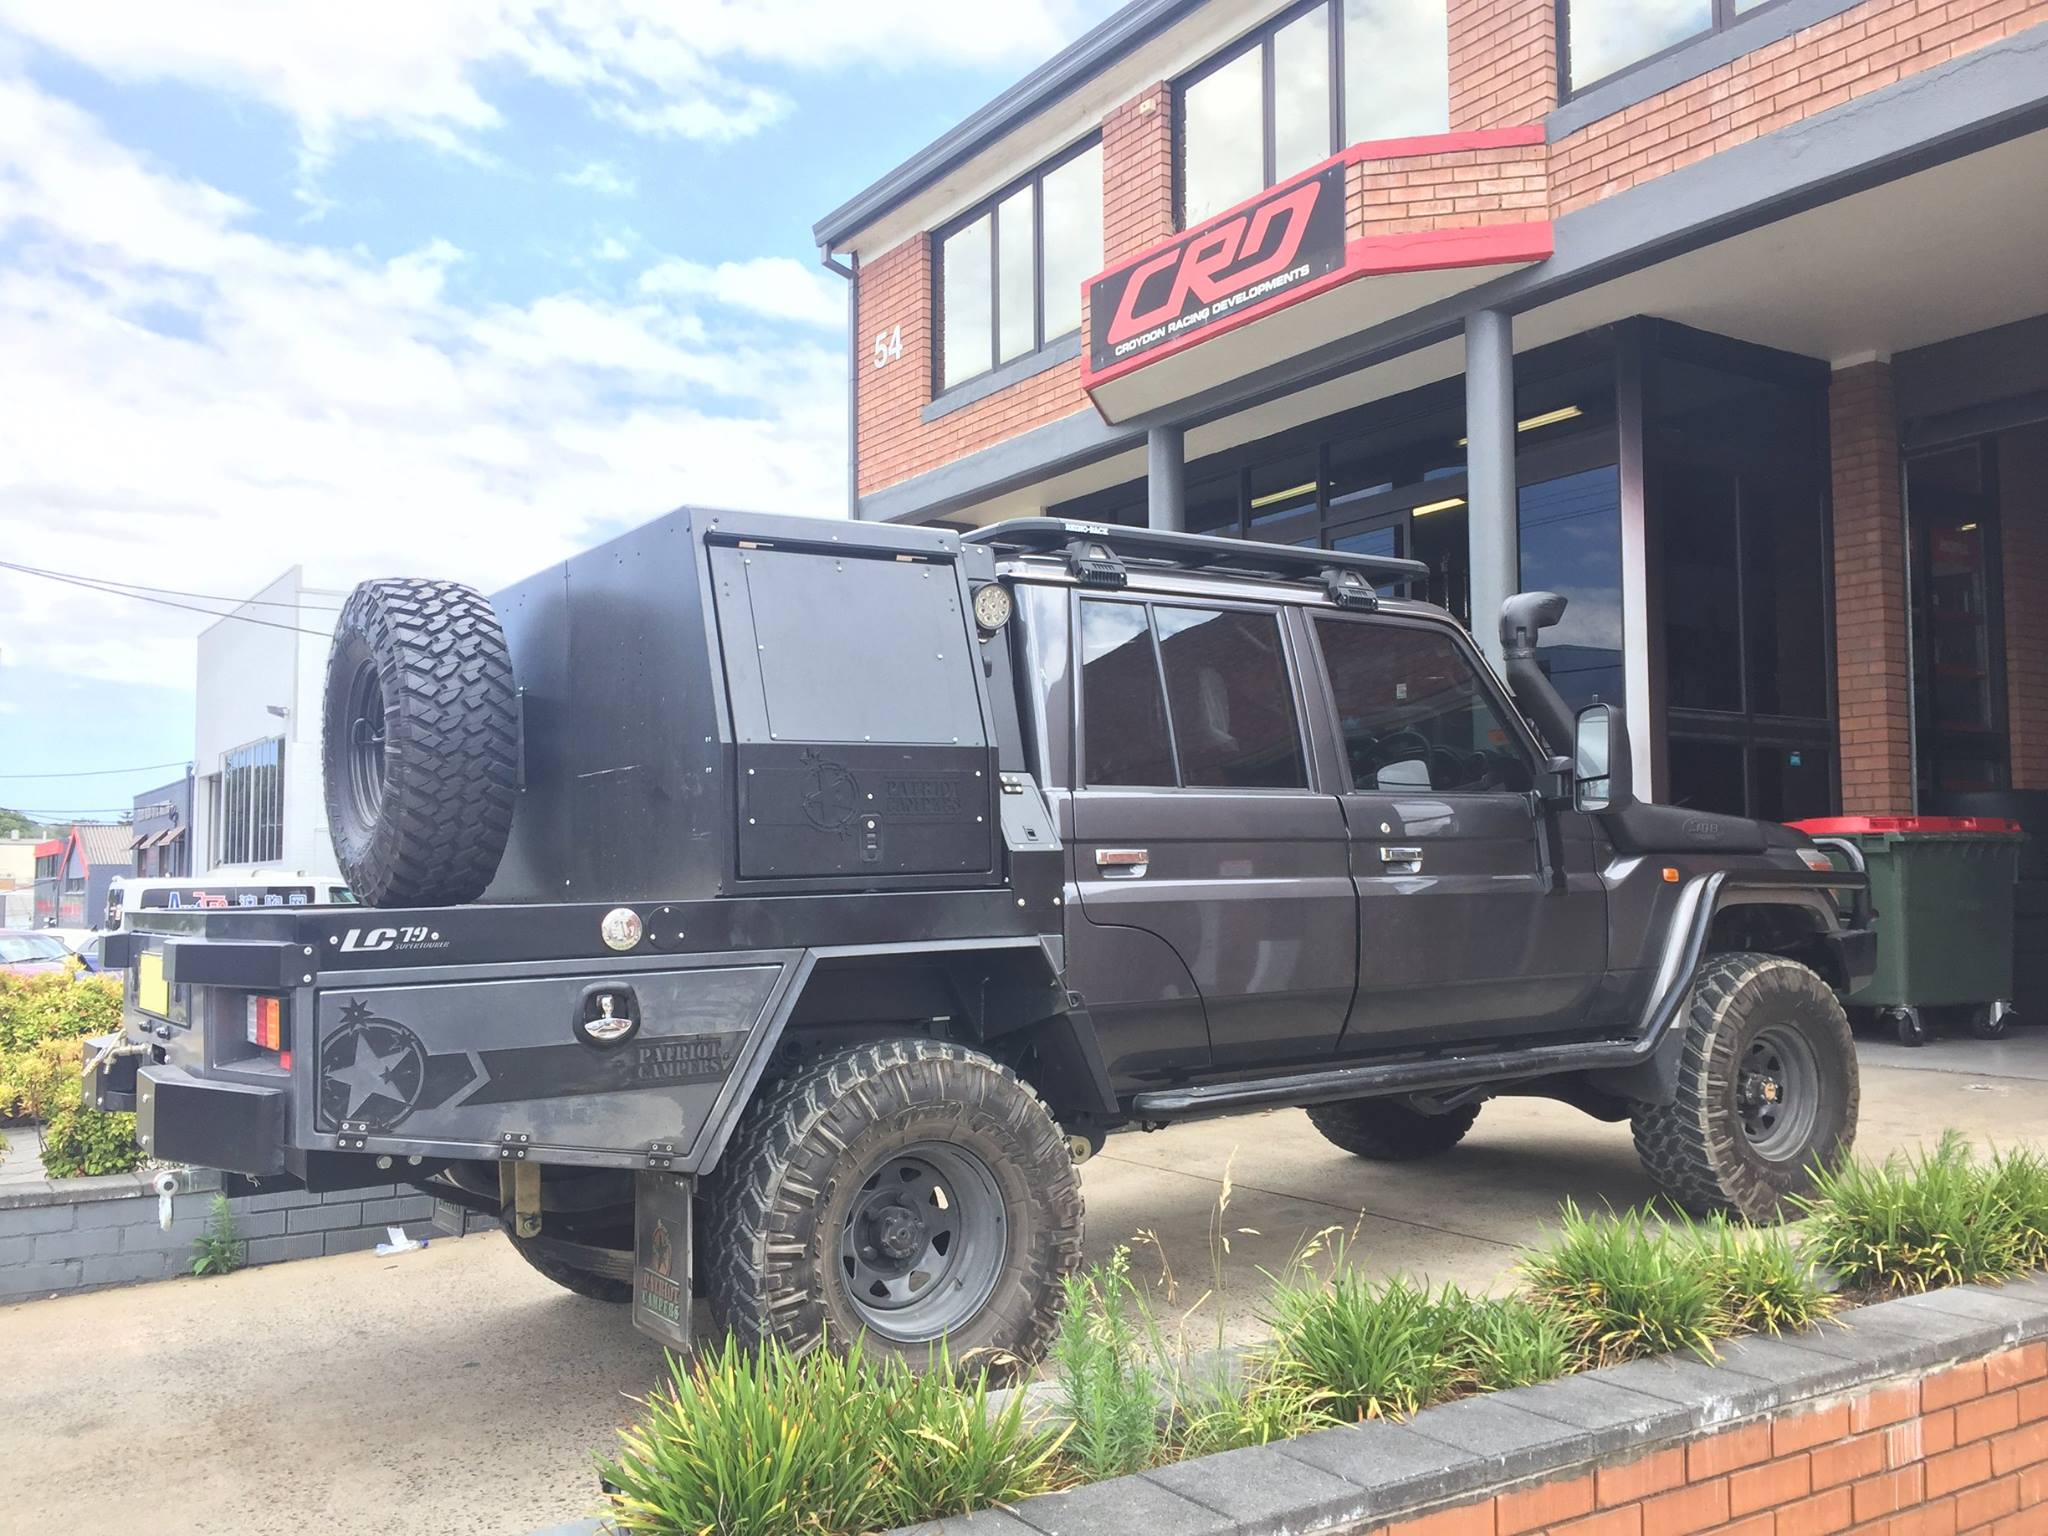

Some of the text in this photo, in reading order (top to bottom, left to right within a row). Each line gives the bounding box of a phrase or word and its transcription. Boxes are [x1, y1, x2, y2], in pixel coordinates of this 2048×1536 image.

[1107, 180, 1321, 345] CRD
[1114, 263, 1310, 356] CROYDON RACING DEVELOPMENTS
[874, 324, 903, 369] 54
[339, 926, 429, 953] LC 79
[637, 1059, 720, 1079] CAMPERS
[639, 1042, 721, 1064] PATRIOT
